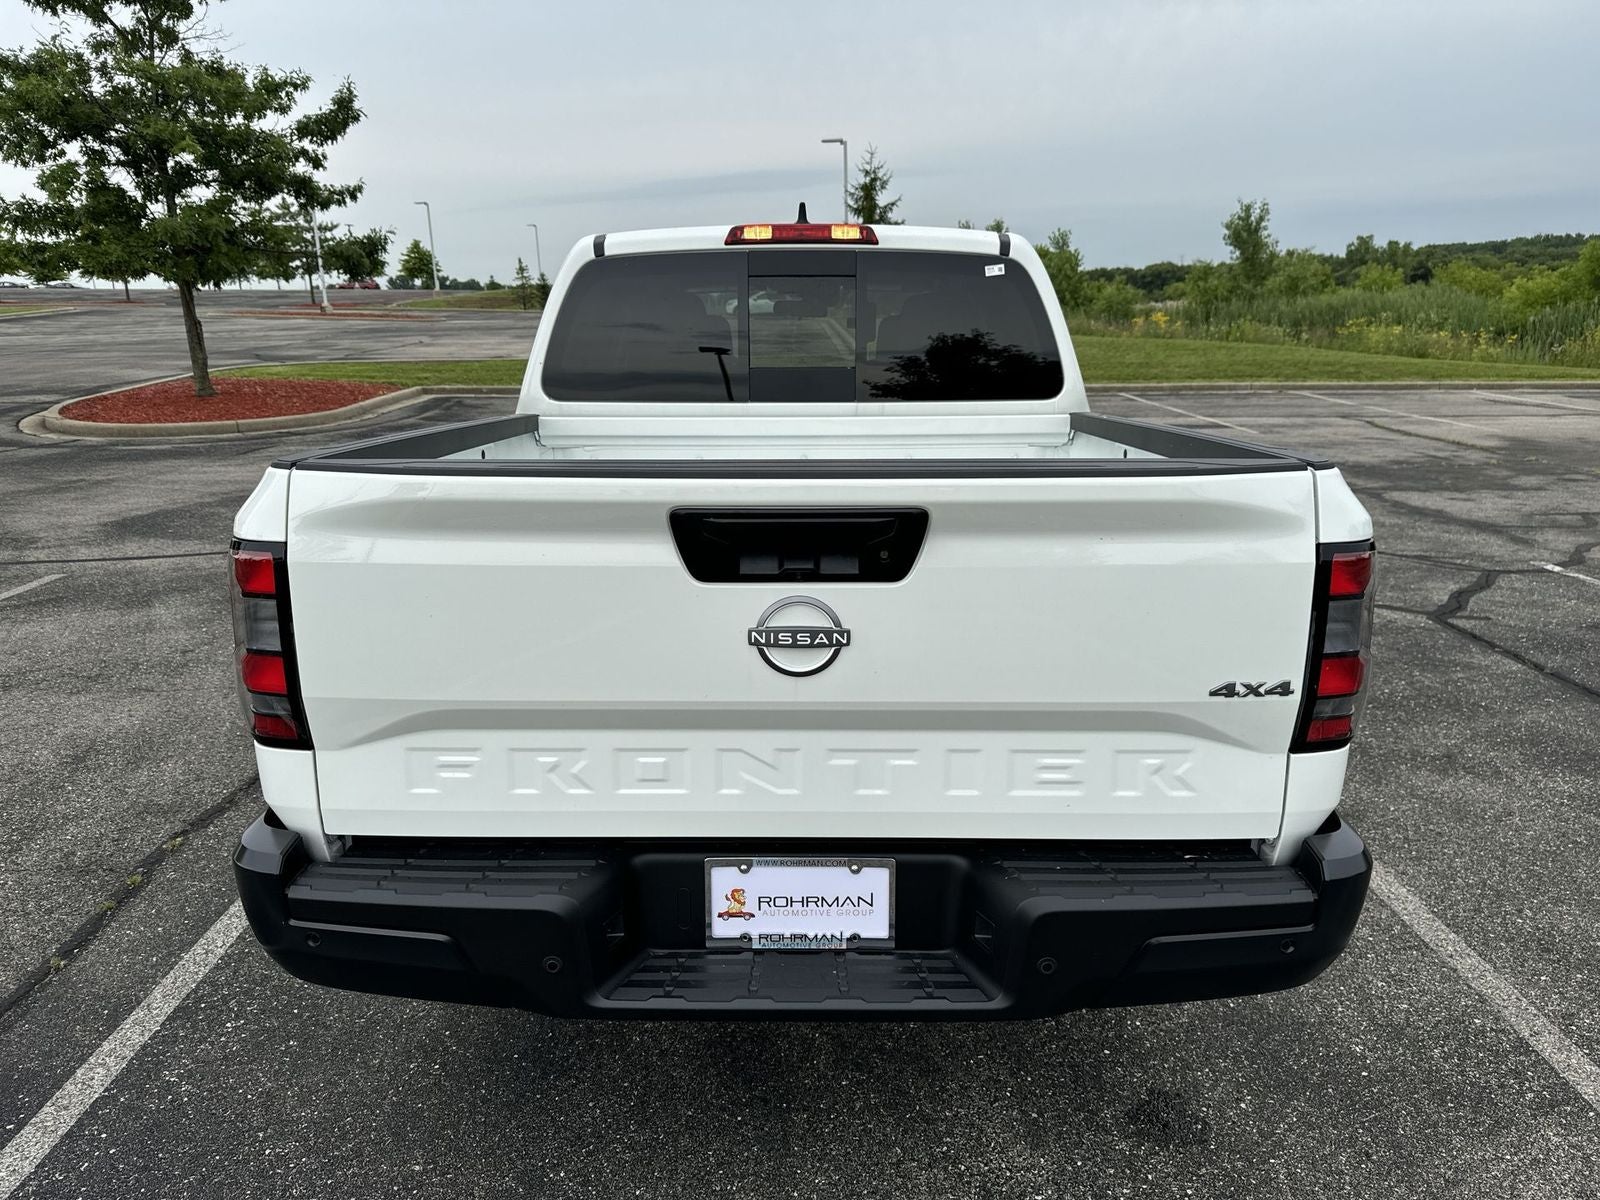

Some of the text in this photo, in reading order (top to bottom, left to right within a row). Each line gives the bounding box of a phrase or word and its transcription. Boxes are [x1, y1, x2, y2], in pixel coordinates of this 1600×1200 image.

[751, 631, 847, 644] NISSAN
[405, 747, 1197, 797] FRONTIER
[755, 859, 847, 867] WWW.ROHRMAN.COM
[758, 892, 874, 911] ROHRMAN
[762, 909, 875, 917] AUTOMOTIVE GROUP
[758, 930, 843, 945] ROHRMAN
